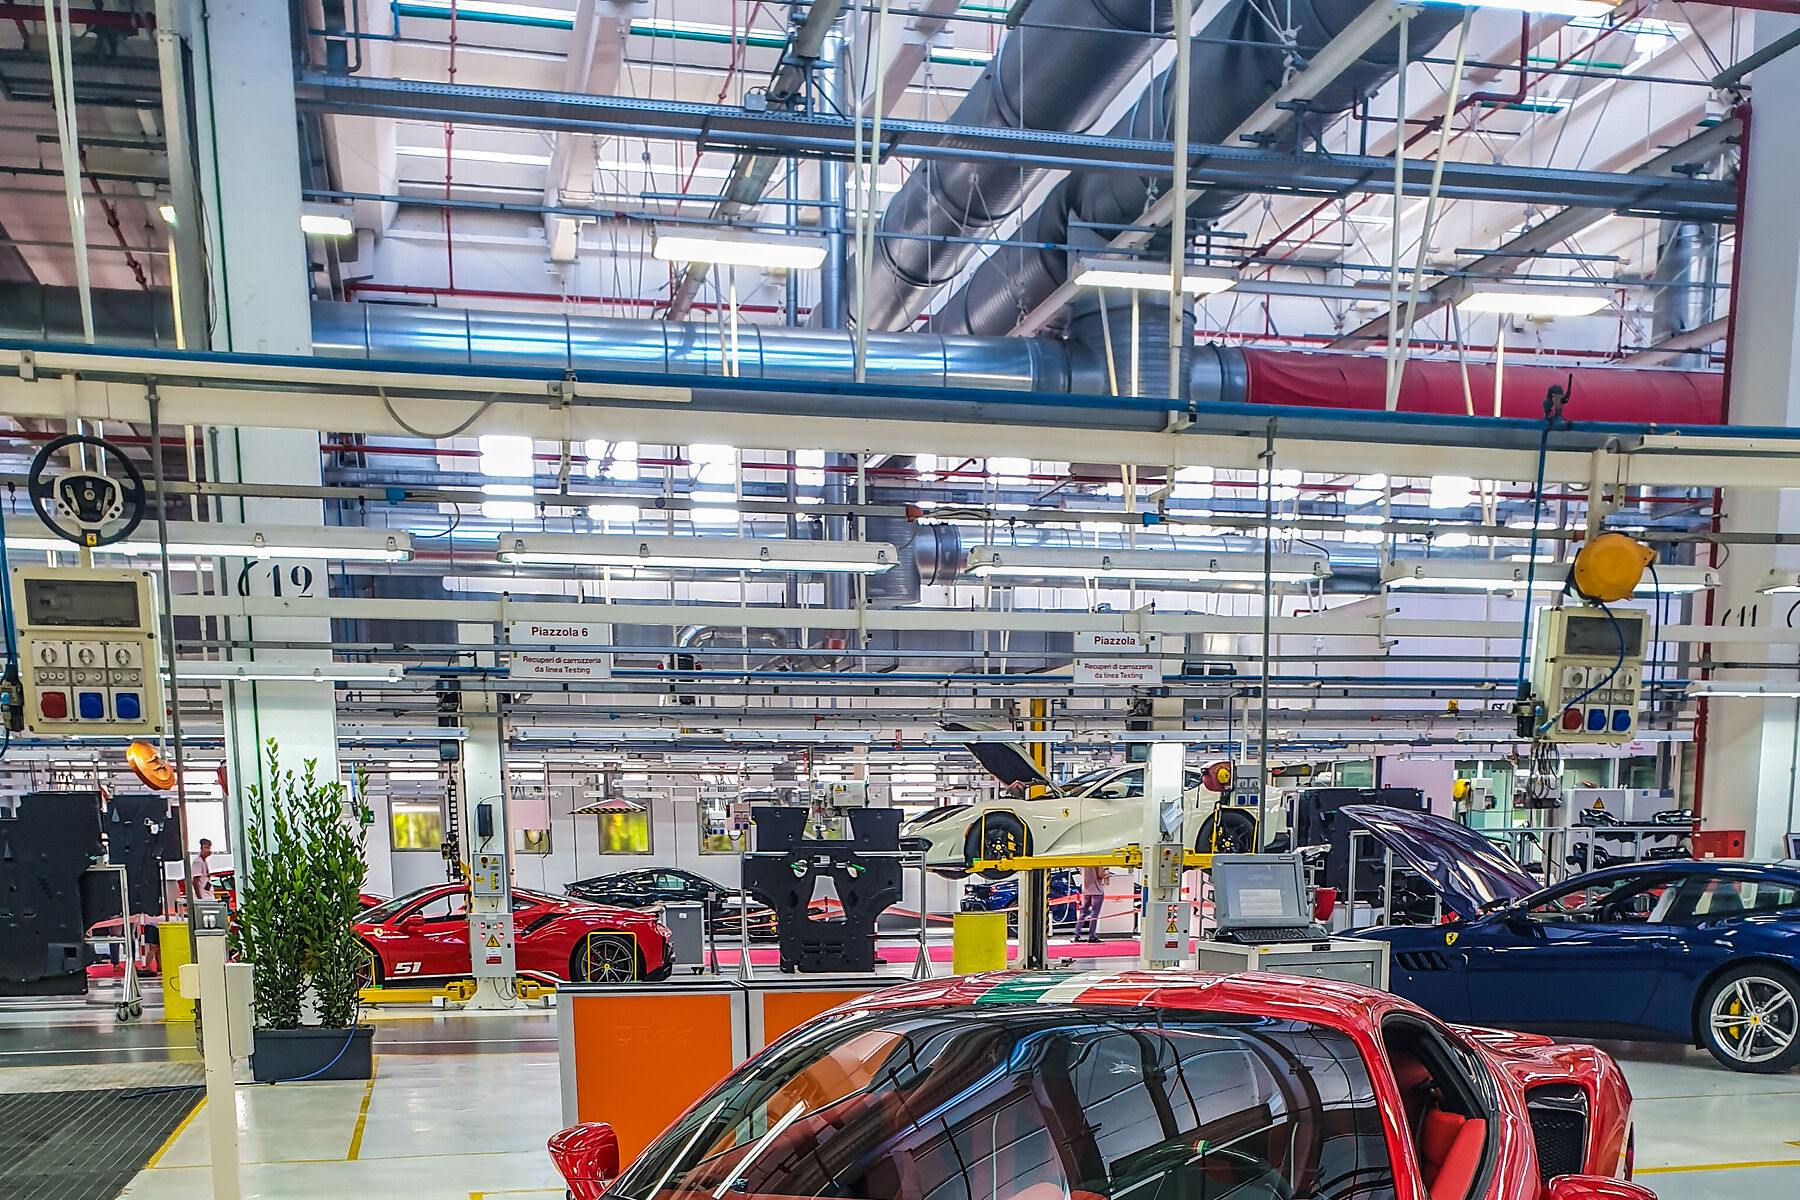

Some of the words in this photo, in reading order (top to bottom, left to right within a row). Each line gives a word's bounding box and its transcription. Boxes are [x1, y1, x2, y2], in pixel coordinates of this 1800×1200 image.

[531, 626, 579, 637] Piazzola
[581, 627, 589, 637] 6
[1094, 636, 1136, 645] Piazzola
[522, 655, 555, 664] Recuperi
[555, 656, 562, 664] di
[563, 656, 602, 664] carrozzeria
[564, 666, 591, 675] Testing
[1084, 662, 1112, 671] Recuperi
[1120, 672, 1144, 680] Testing
[393, 961, 422, 975] 51
